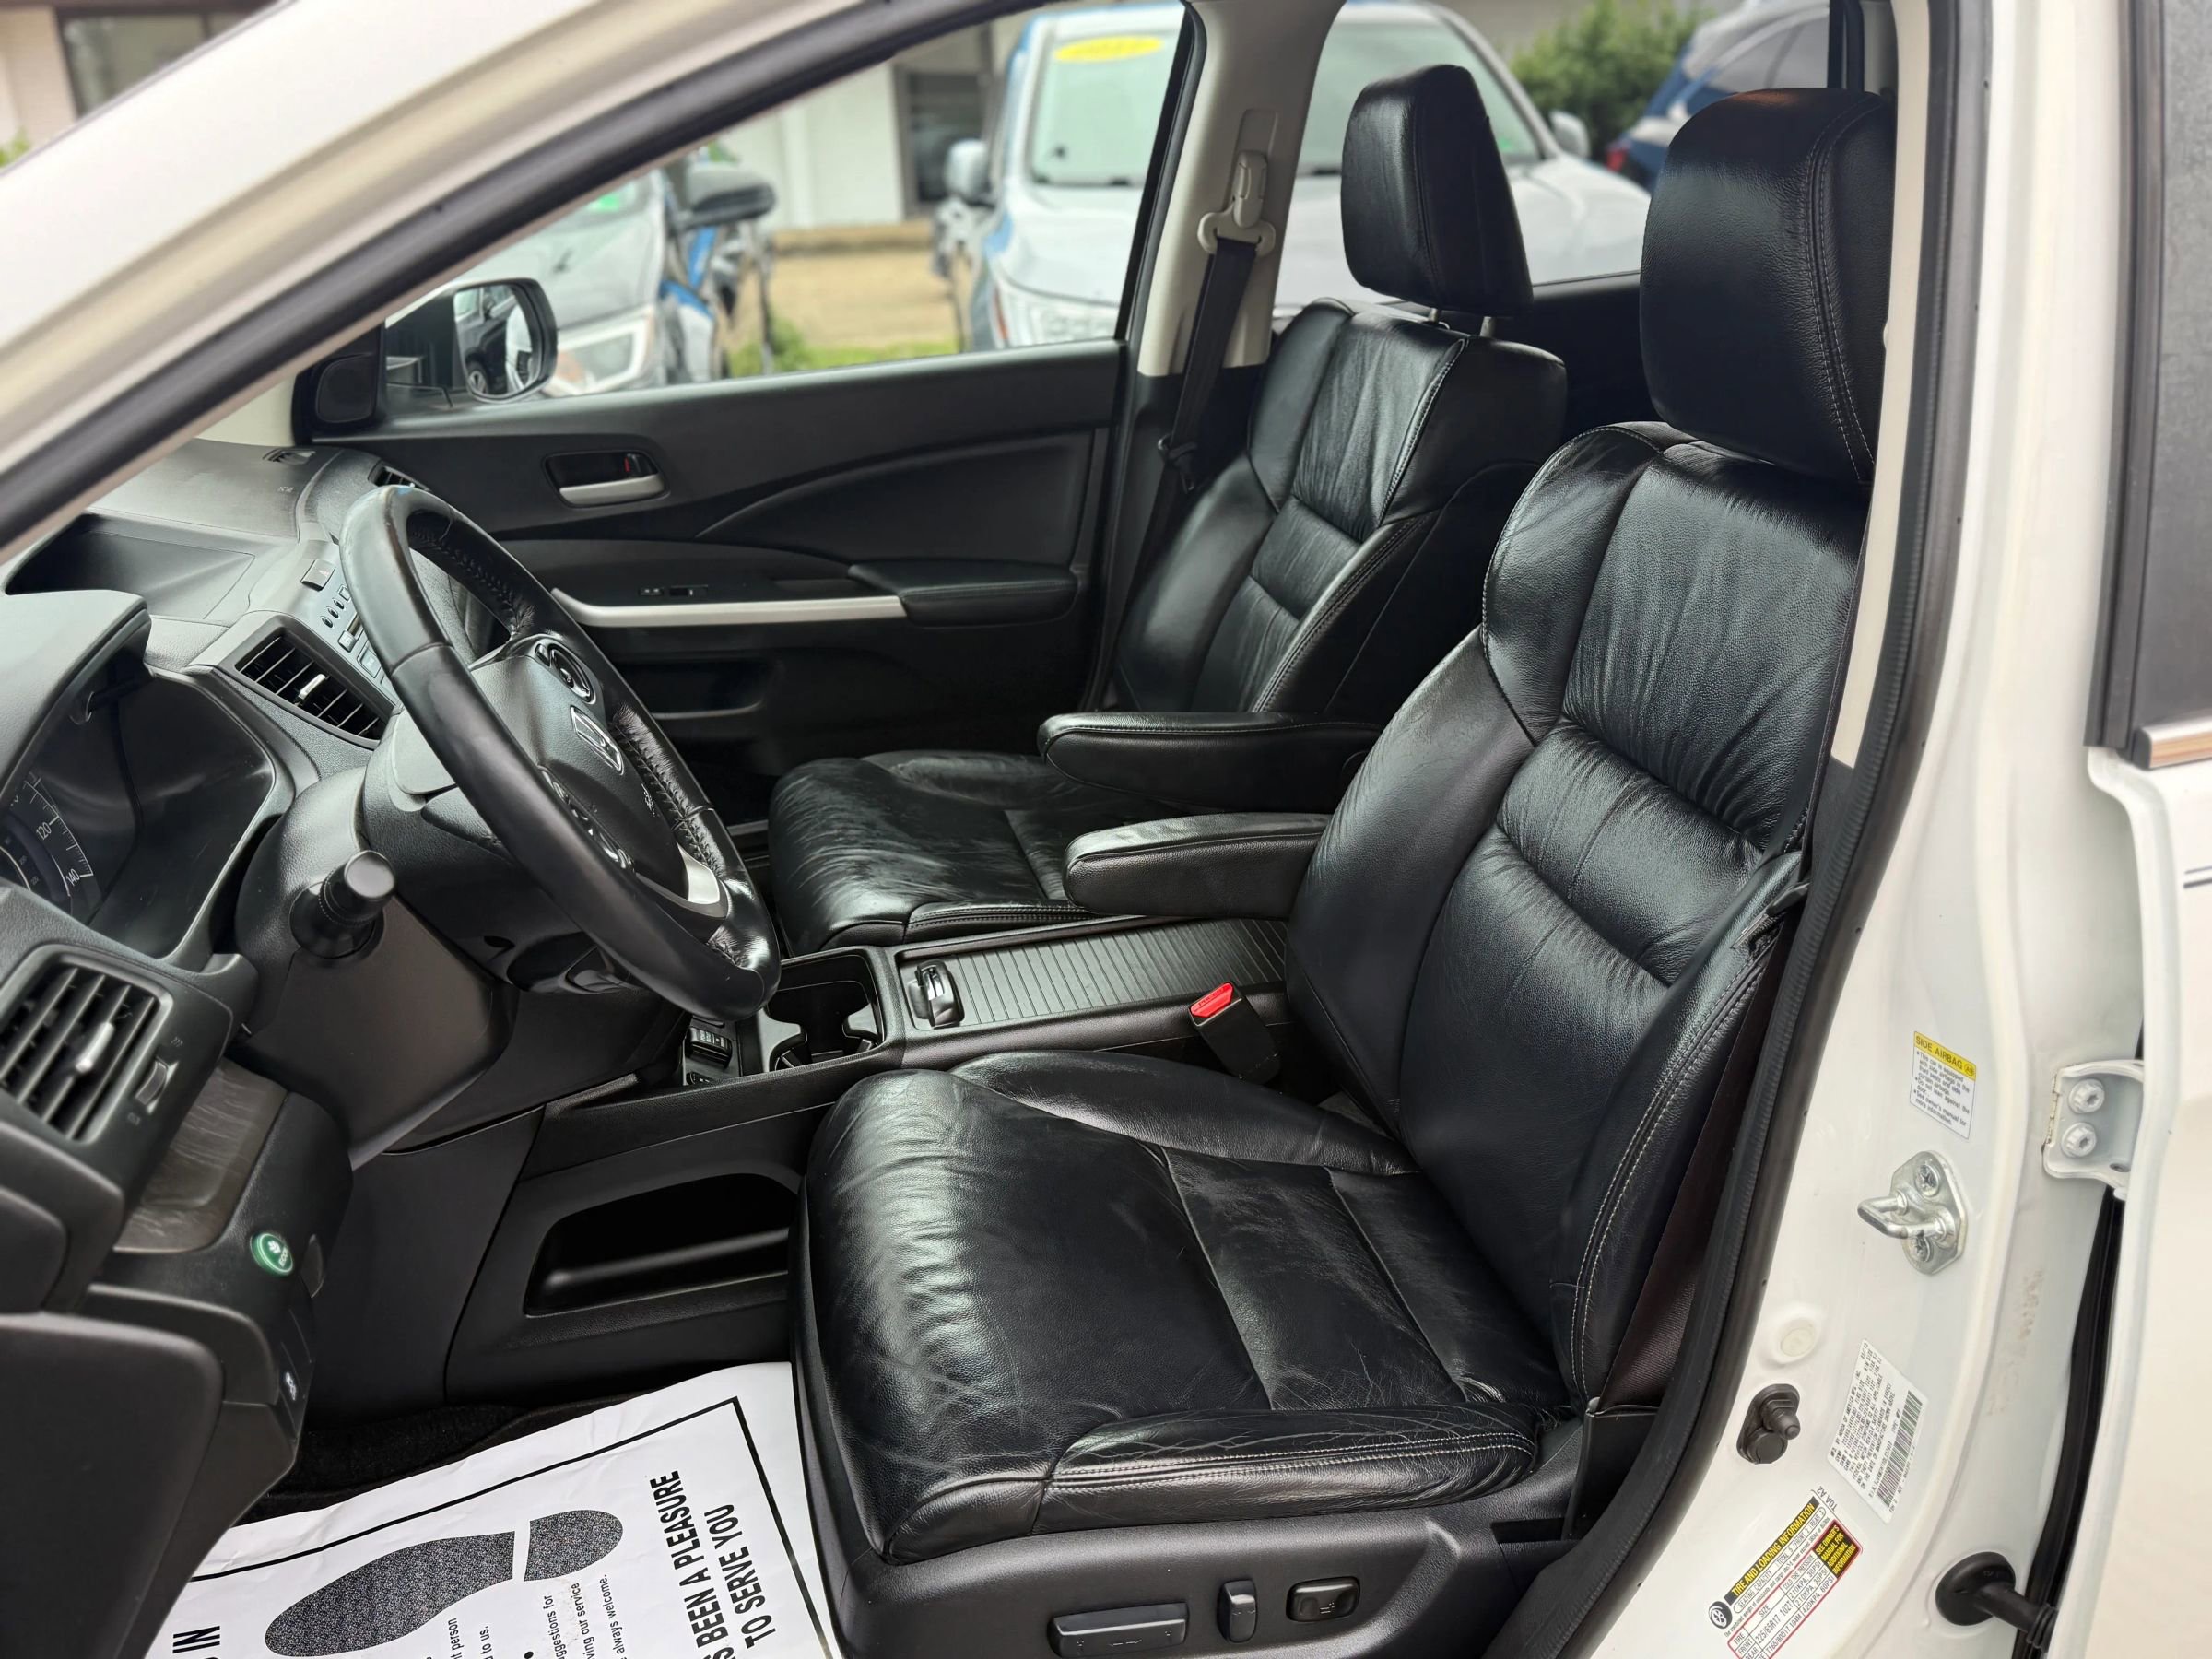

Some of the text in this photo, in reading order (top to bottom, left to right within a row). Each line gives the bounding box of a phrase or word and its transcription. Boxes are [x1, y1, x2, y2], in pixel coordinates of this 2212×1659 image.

[36, 822, 52, 841] 120
[65, 868, 80, 887] 140
[1916, 1036, 1932, 1052] SIDE
[1936, 1047, 1962, 1070] AIRBAG
[1943, 1108, 1959, 1123] manual
[1817, 1486, 1829, 1500] A2
[649, 1470, 704, 1570] PLEASURE
[704, 1504, 742, 1549] YOU
[1809, 1514, 1821, 1527] REAR
[1732, 1502, 1816, 1597] TIRE AND LOADING INFORMATION
[1794, 1532, 1806, 1547] FRONT
[1815, 1524, 1841, 1555] SEE OWNER'S
[1820, 1532, 1845, 1562] MANUAL FOR
[1777, 1552, 1789, 1565] TOTAL
[1826, 1541, 1849, 1568] ADDITIONAL
[1830, 1544, 1858, 1575] INFORMATION
[679, 1567, 711, 1586] A
[718, 1546, 765, 1614] SERVE
[1806, 1559, 1822, 1578] 30PSI
[1813, 1567, 1829, 1585] 30PSI
[1738, 1570, 1772, 1608] SEATING CAPACITY
[1819, 1574, 1835, 1593] 60PSI
[571, 1583, 586, 1617] service
[1759, 1604, 1771, 1618] SIZE
[599, 1574, 625, 1654] always welcome.
[684, 1587, 728, 1648] BEEN
[1755, 1614, 1782, 1644] 225/65R17
[1779, 1600, 1794, 1617] 102T
[1789, 1613, 1802, 1628] 104M
[448, 1618, 465, 1650] person
[479, 1626, 490, 1641] us.
[543, 1595, 568, 1659] ggestions for
[579, 1619, 590, 1635] our
[741, 1615, 776, 1649] TO
[1734, 1632, 1745, 1645] TIRE
[172, 1626, 220, 1653] IN
[480, 1643, 491, 1654] to
[1737, 1637, 1753, 1655] FRONT
